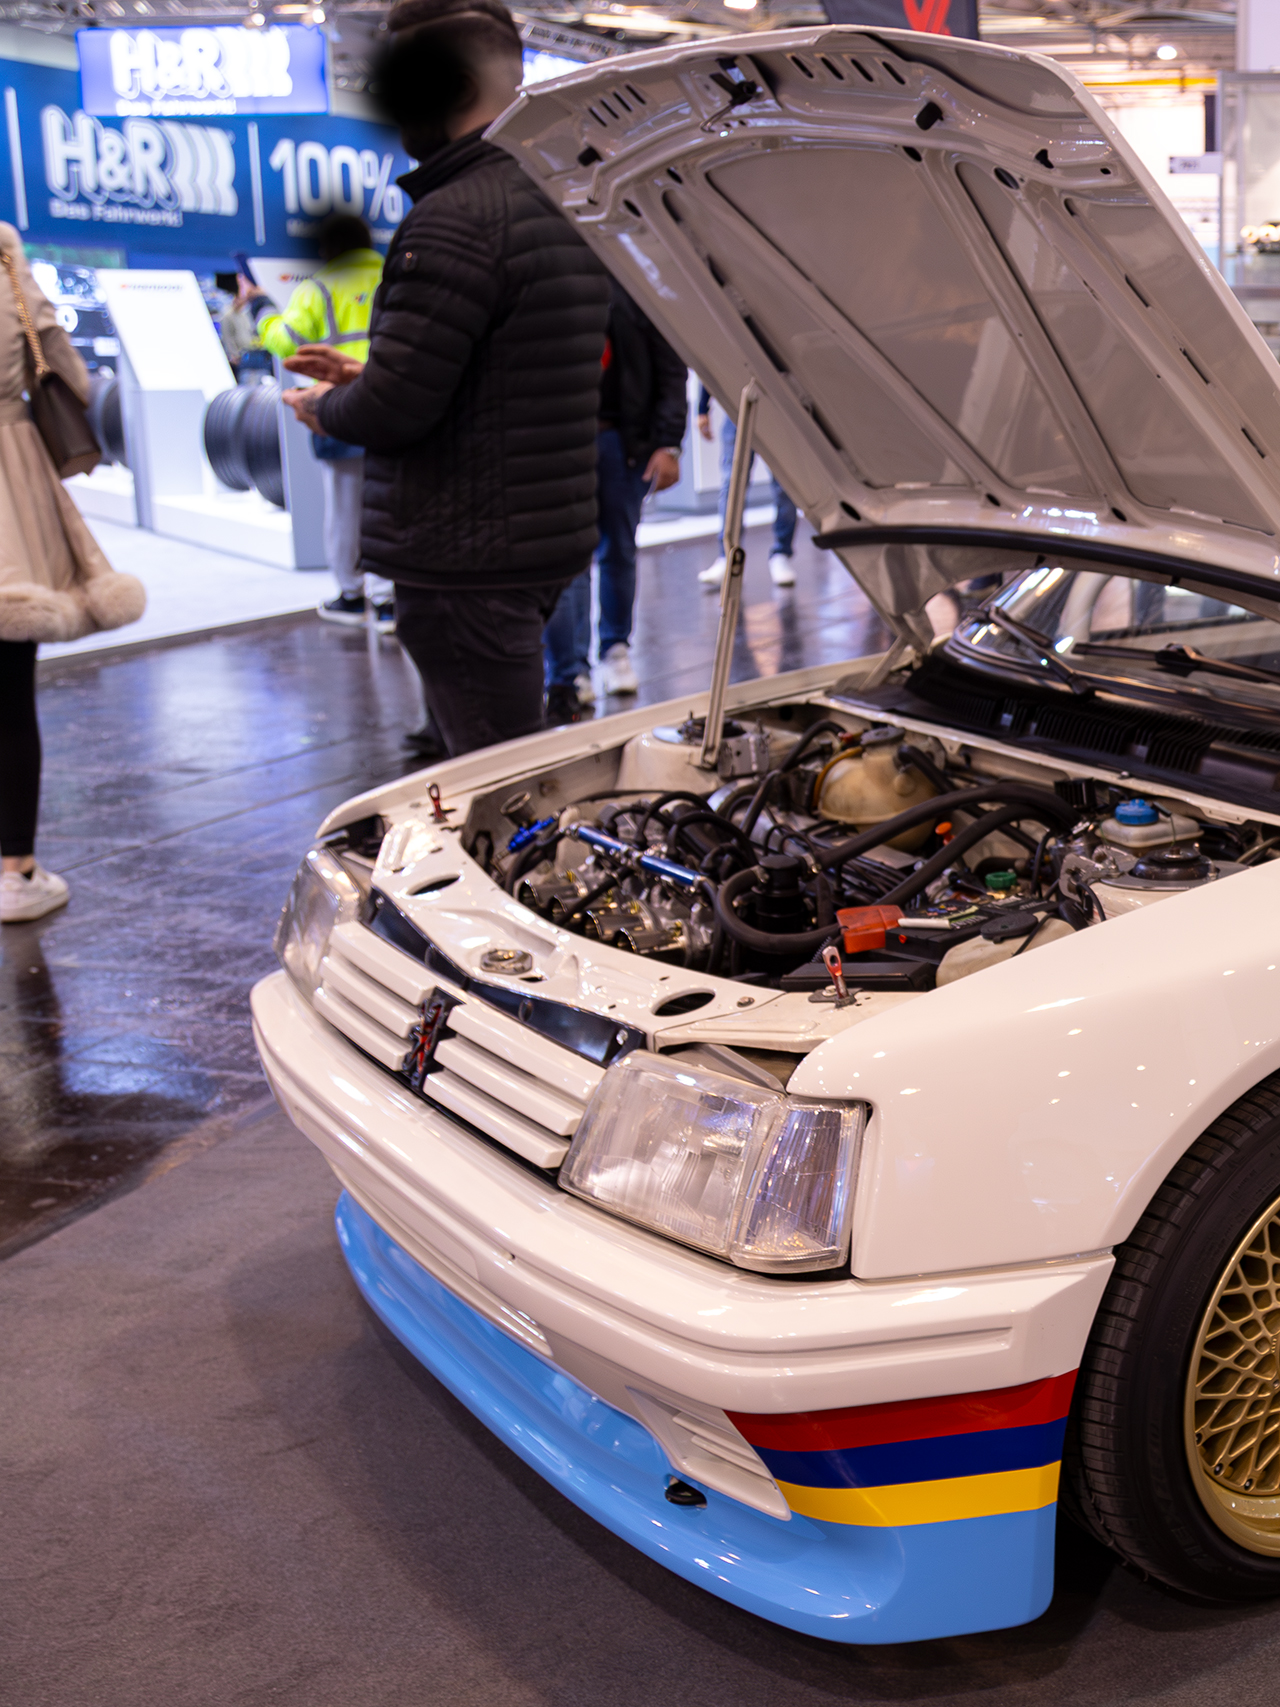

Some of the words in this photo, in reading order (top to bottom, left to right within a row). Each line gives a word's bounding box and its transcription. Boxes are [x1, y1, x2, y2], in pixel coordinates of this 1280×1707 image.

[111, 28, 236, 99] H&R
[41, 104, 181, 211] H&R
[269, 138, 404, 224] 100%
